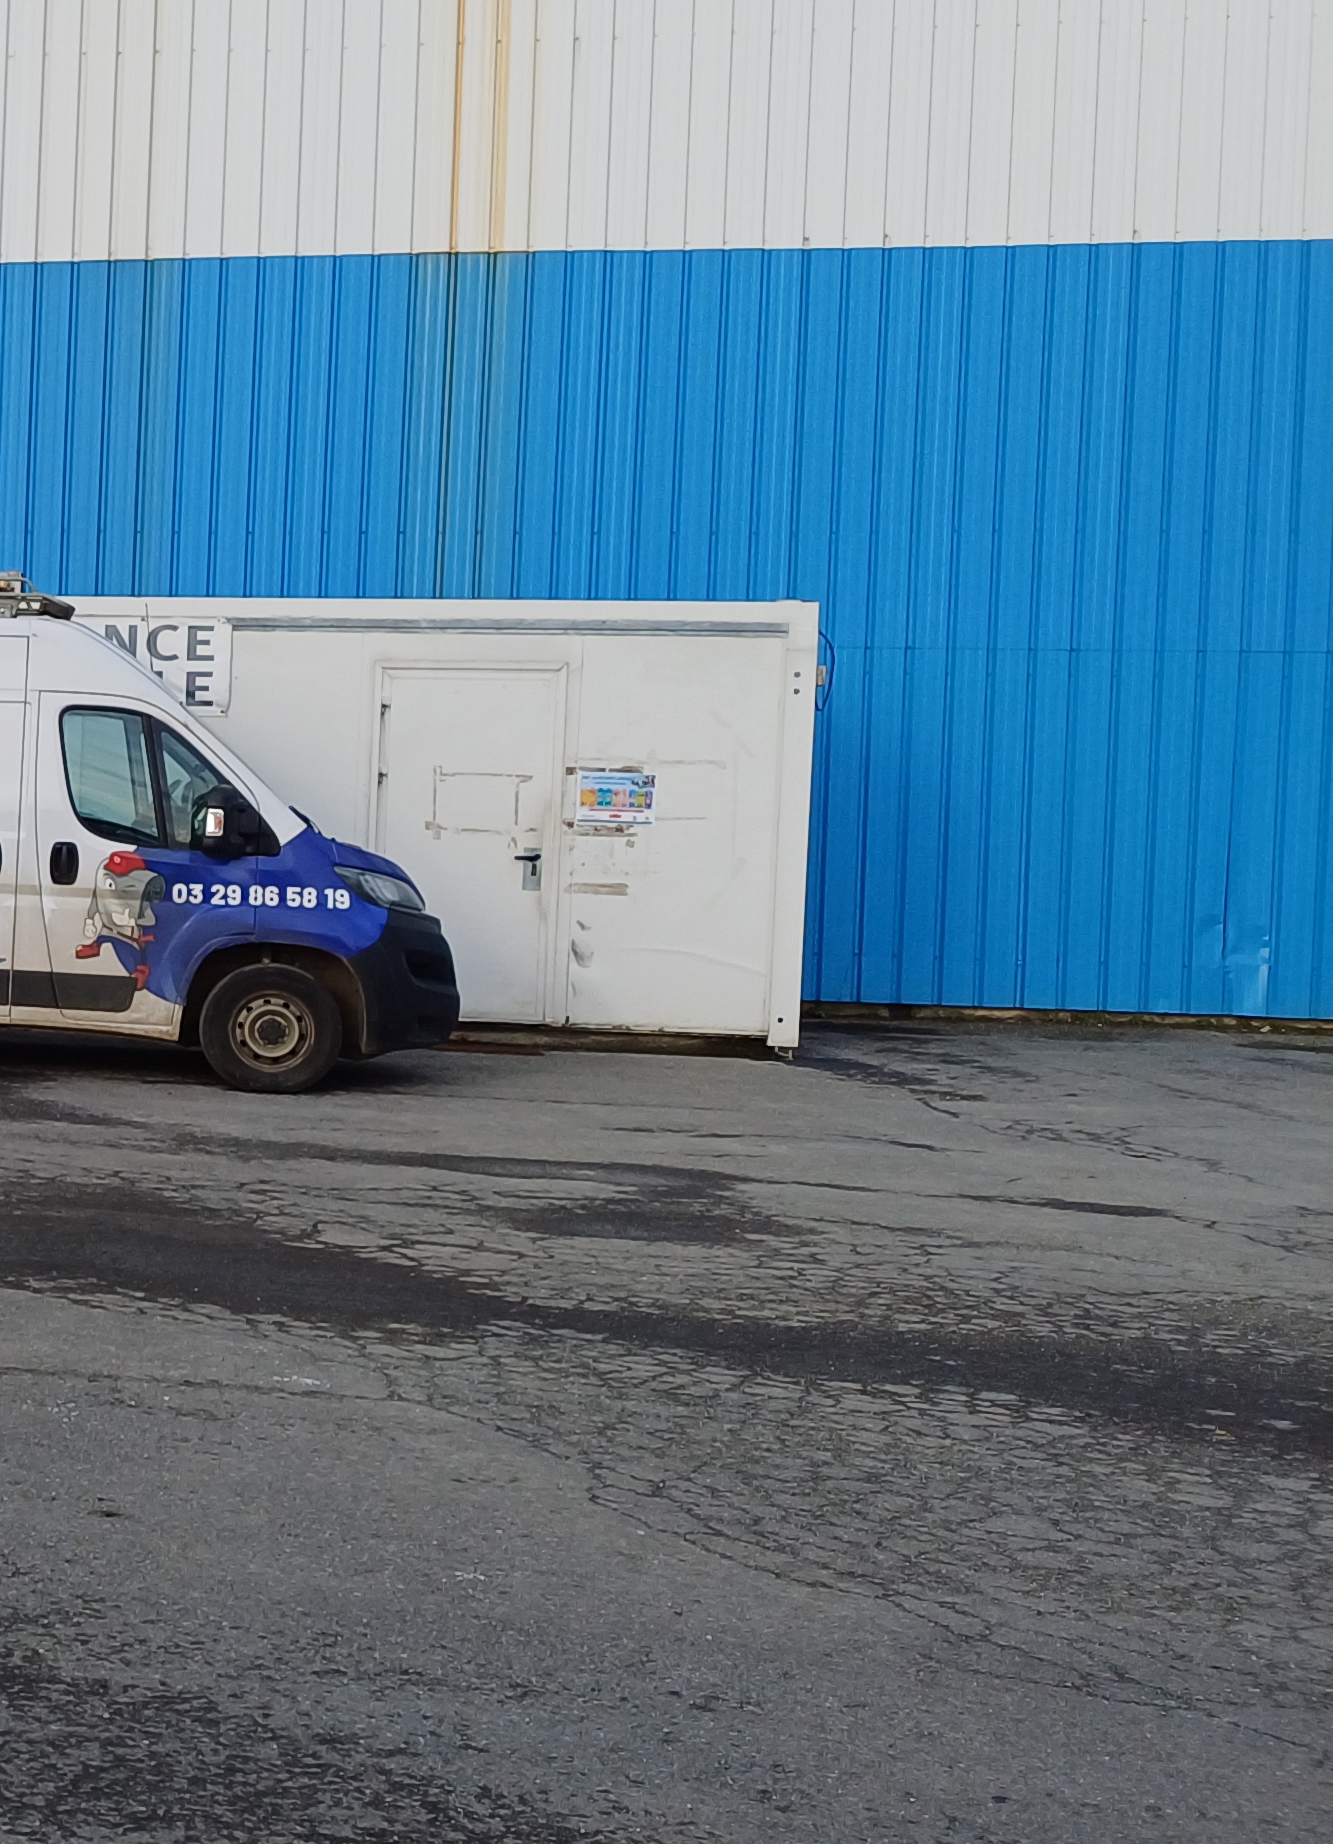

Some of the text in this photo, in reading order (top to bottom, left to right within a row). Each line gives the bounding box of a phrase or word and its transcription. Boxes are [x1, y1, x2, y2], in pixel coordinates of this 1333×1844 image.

[172, 882, 351, 910] 03 29 86 58 19
